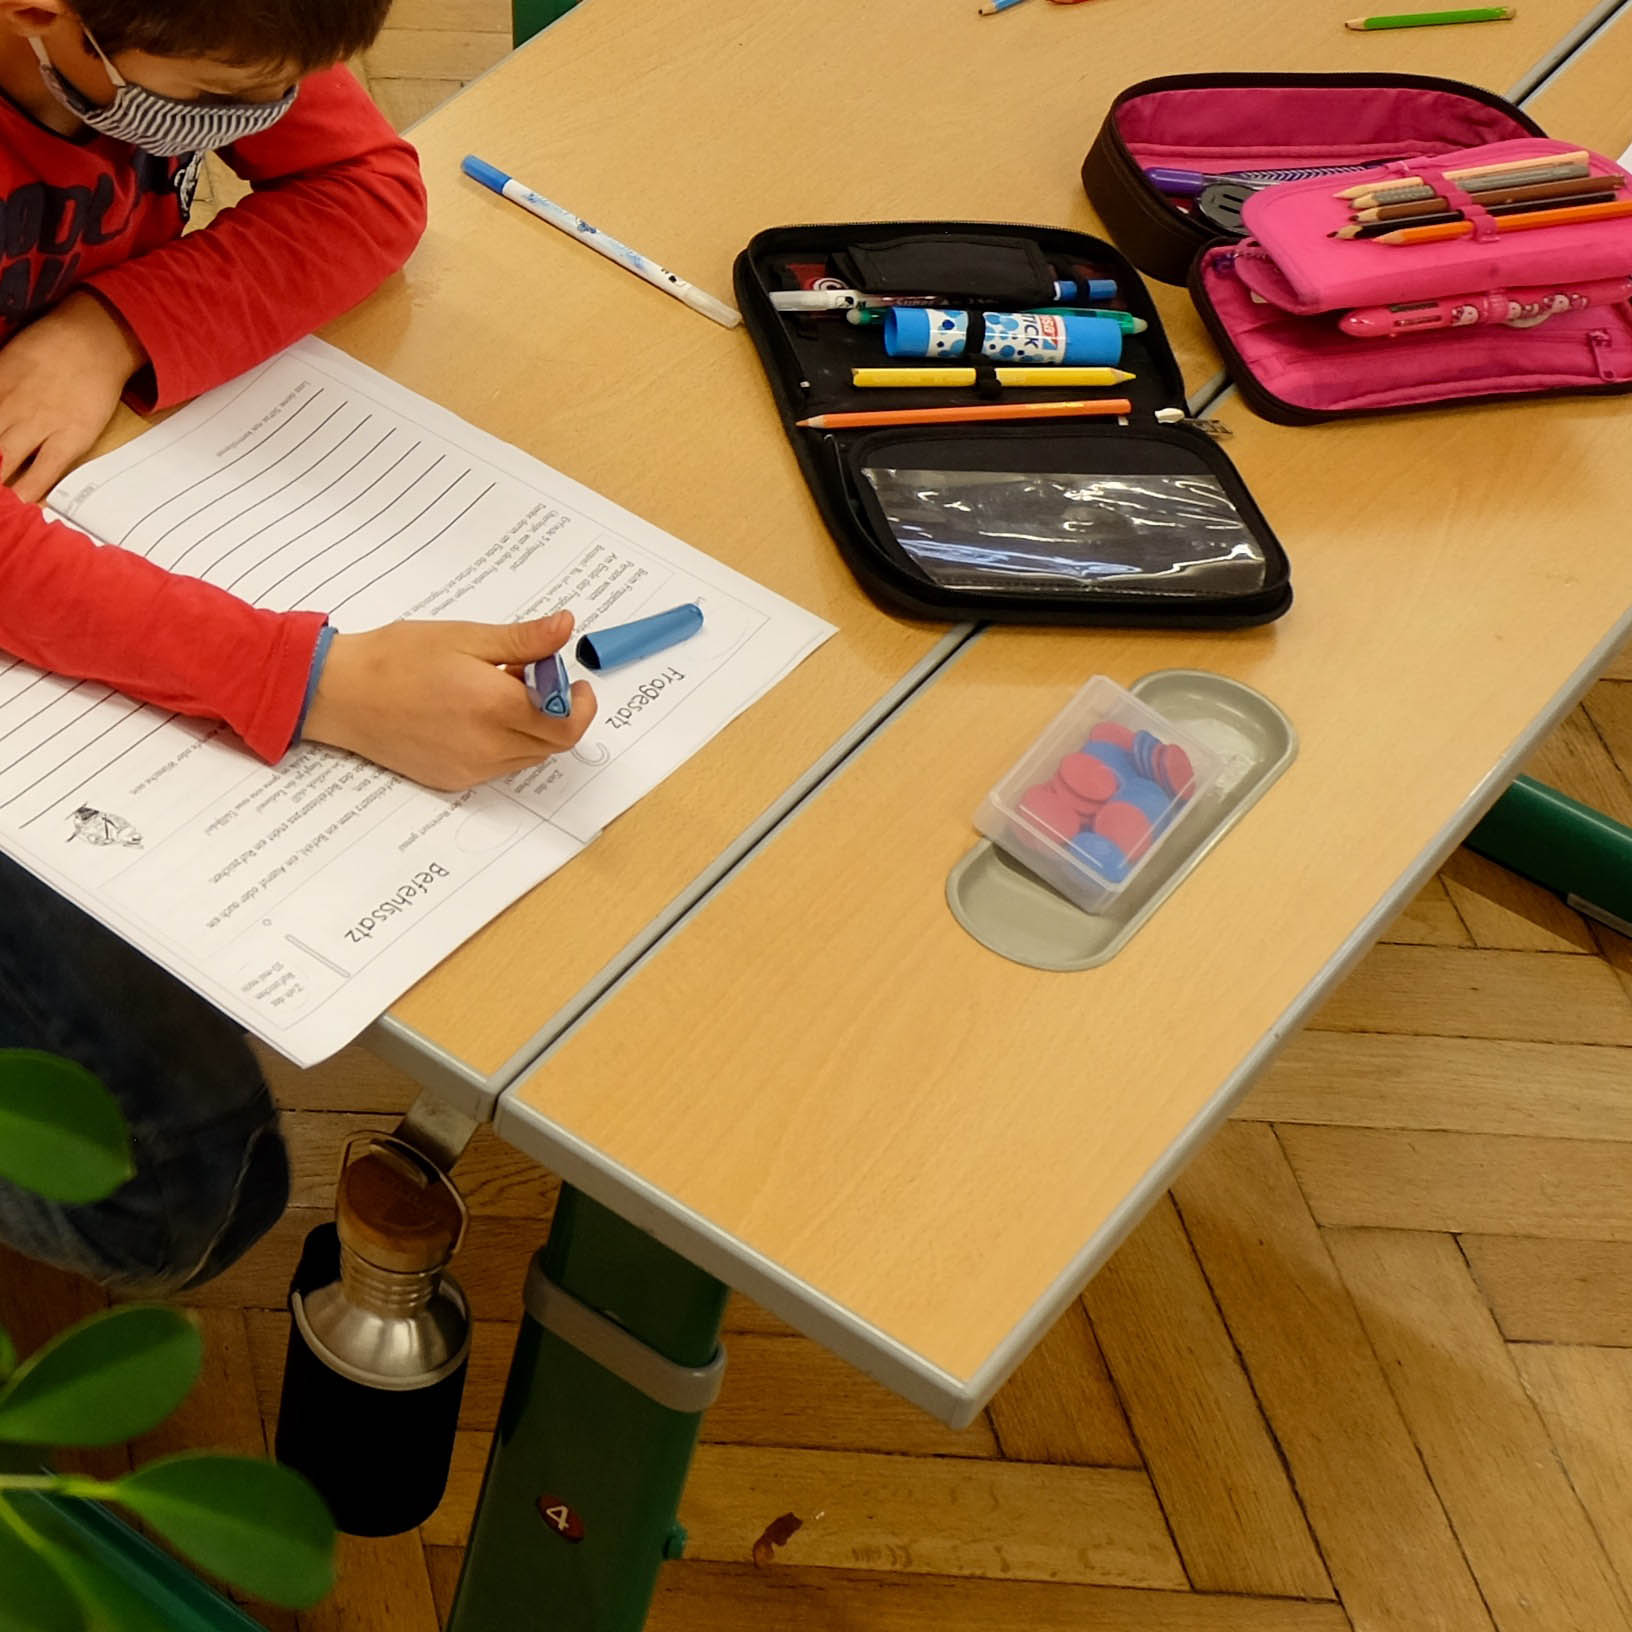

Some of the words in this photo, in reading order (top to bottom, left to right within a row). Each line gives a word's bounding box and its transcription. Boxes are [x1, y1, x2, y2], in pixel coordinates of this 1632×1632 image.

[605, 664, 686, 733] Fragesatz
[343, 860, 448, 949] Befehlssatz
[544, 1502, 572, 1533] 4
